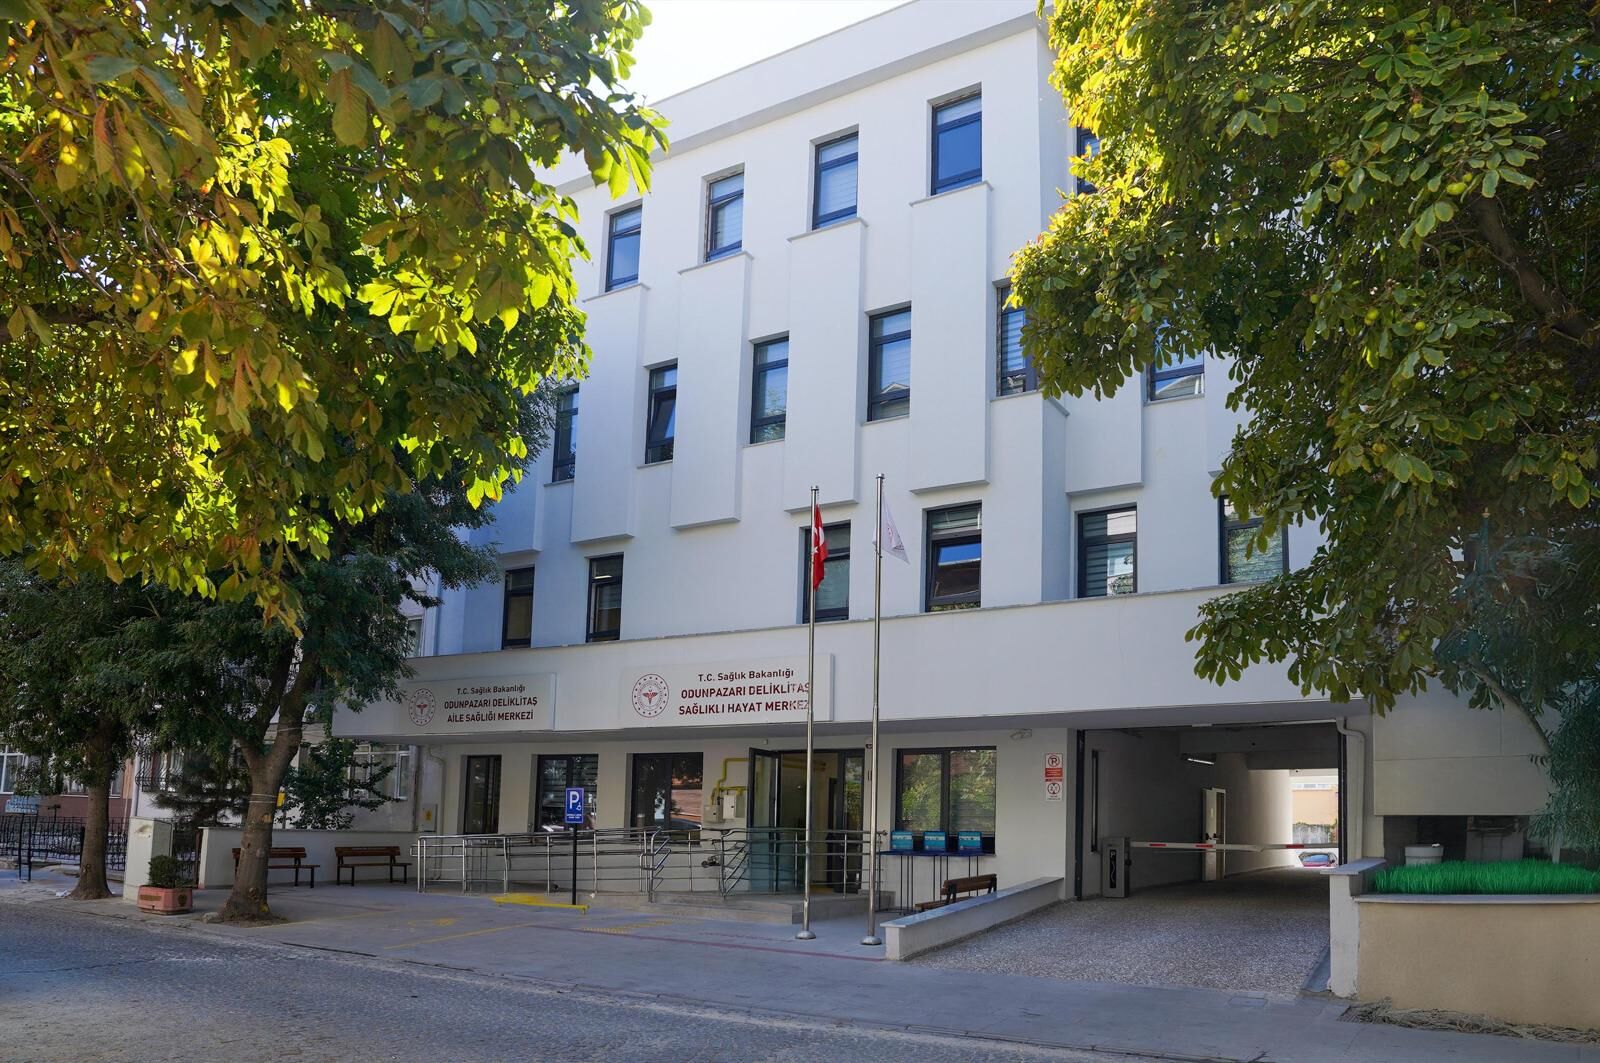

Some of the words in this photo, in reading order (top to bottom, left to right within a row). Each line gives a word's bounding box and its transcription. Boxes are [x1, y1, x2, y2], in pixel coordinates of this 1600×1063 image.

[698, 673, 716, 682] T.C.
[717, 671, 747, 683] Sağlık
[749, 668, 794, 680] Bakanlığı
[456, 687, 470, 696] T.C.
[470, 685, 492, 696] Sağlık
[493, 684, 526, 695] Bakanlığı
[681, 686, 746, 699] ODUNPAZARI
[444, 699, 491, 710] ODUNPAZARI
[493, 696, 538, 708] DELİKLİTAŞ
[727, 700, 763, 714] HAYAT
[764, 699, 809, 713] MERKEZ
[447, 712, 465, 723] AİLE
[465, 710, 496, 722] SAĞLIĞI
[497, 708, 534, 721] MERKEZİ
[570, 791, 579, 809] P
